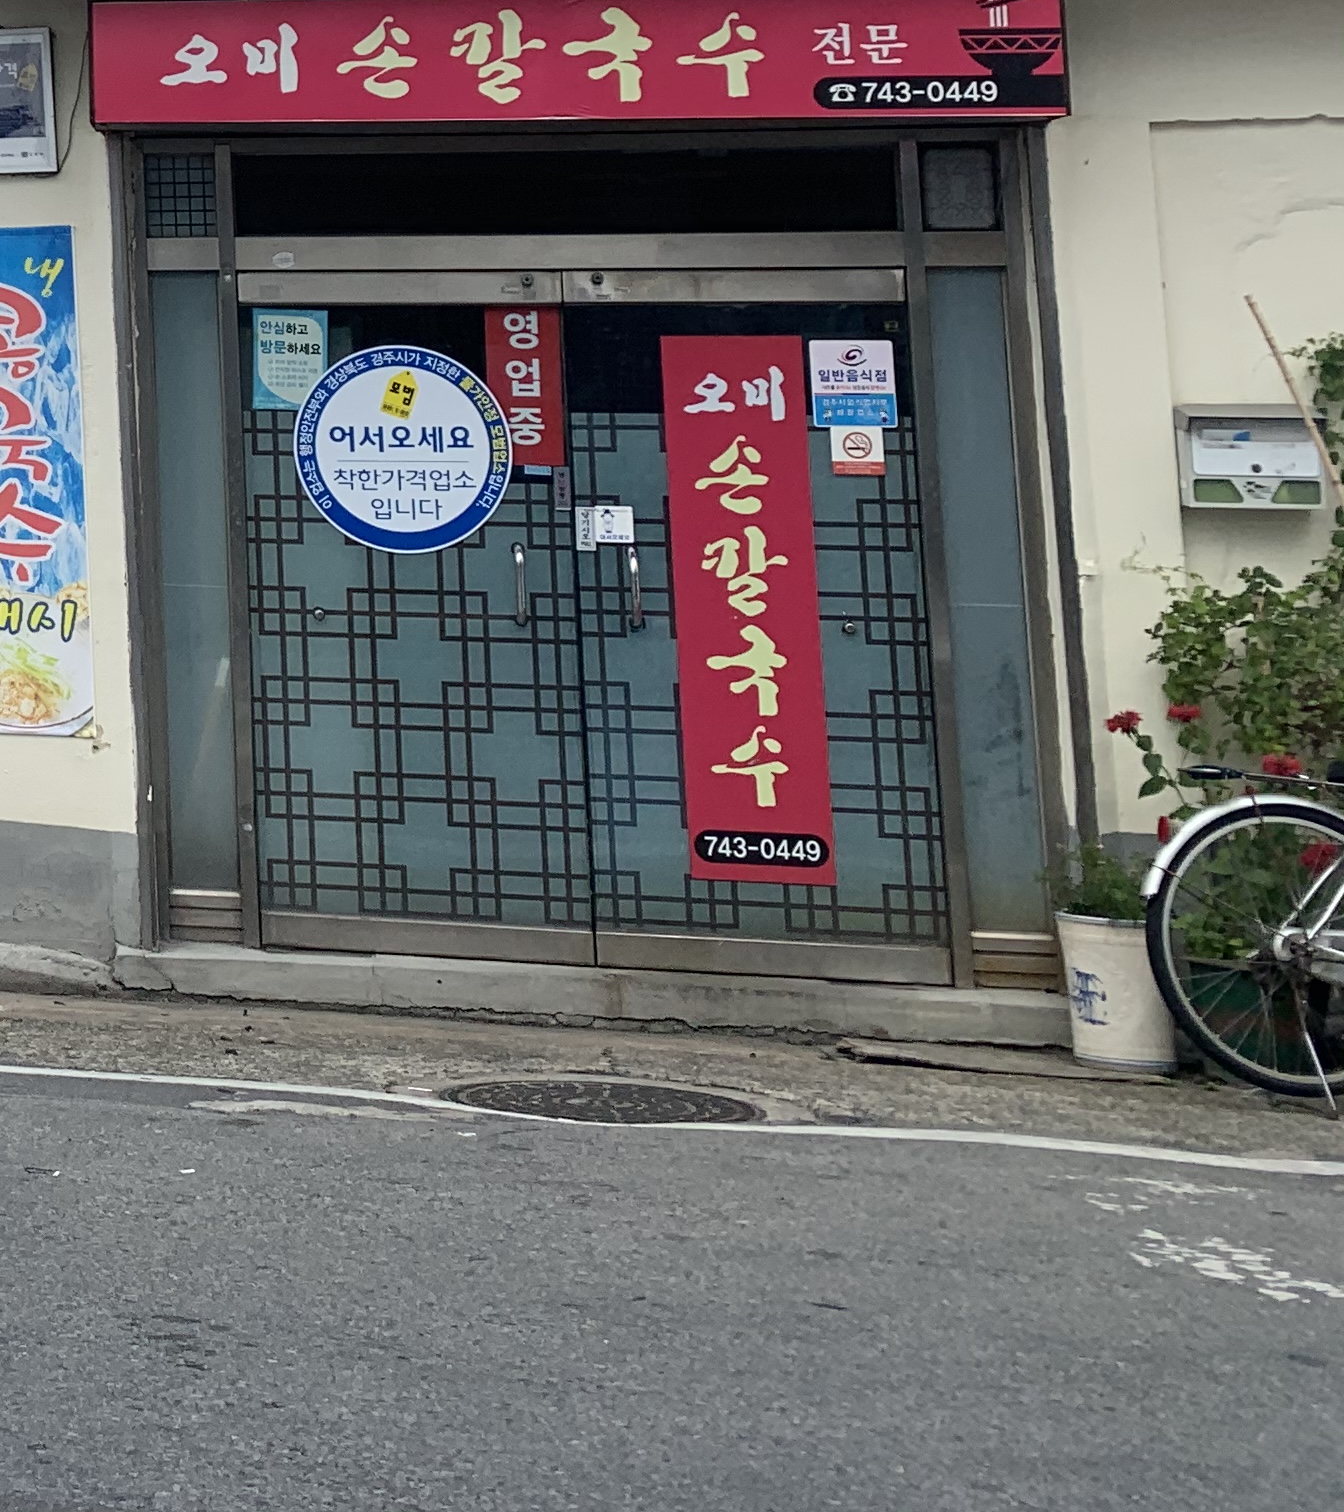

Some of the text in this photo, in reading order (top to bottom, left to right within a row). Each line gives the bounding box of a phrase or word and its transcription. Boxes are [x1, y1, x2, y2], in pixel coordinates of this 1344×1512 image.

[812, 22, 910, 67] 전문
[860, 79, 999, 103] 743-0449
[24, 256, 65, 299] 냉
[260, 321, 309, 336] 안심하고
[260, 340, 322, 356] 방문하세요
[371, 351, 421, 367] 경주시가
[324, 358, 369, 390] 경상북도
[424, 355, 461, 381] 지정한
[503, 310, 545, 447] 영업중
[818, 369, 888, 383] 일반음식점
[389, 381, 415, 407] 모범
[684, 364, 786, 422] 오미
[329, 425, 474, 453] 어서오세요
[302, 459, 328, 495] 업소는
[333, 468, 477, 492] 착한가격업소
[318, 494, 333, 510] 이
[371, 498, 443, 521] 입니다
[703, 834, 822, 864] 743-0449
